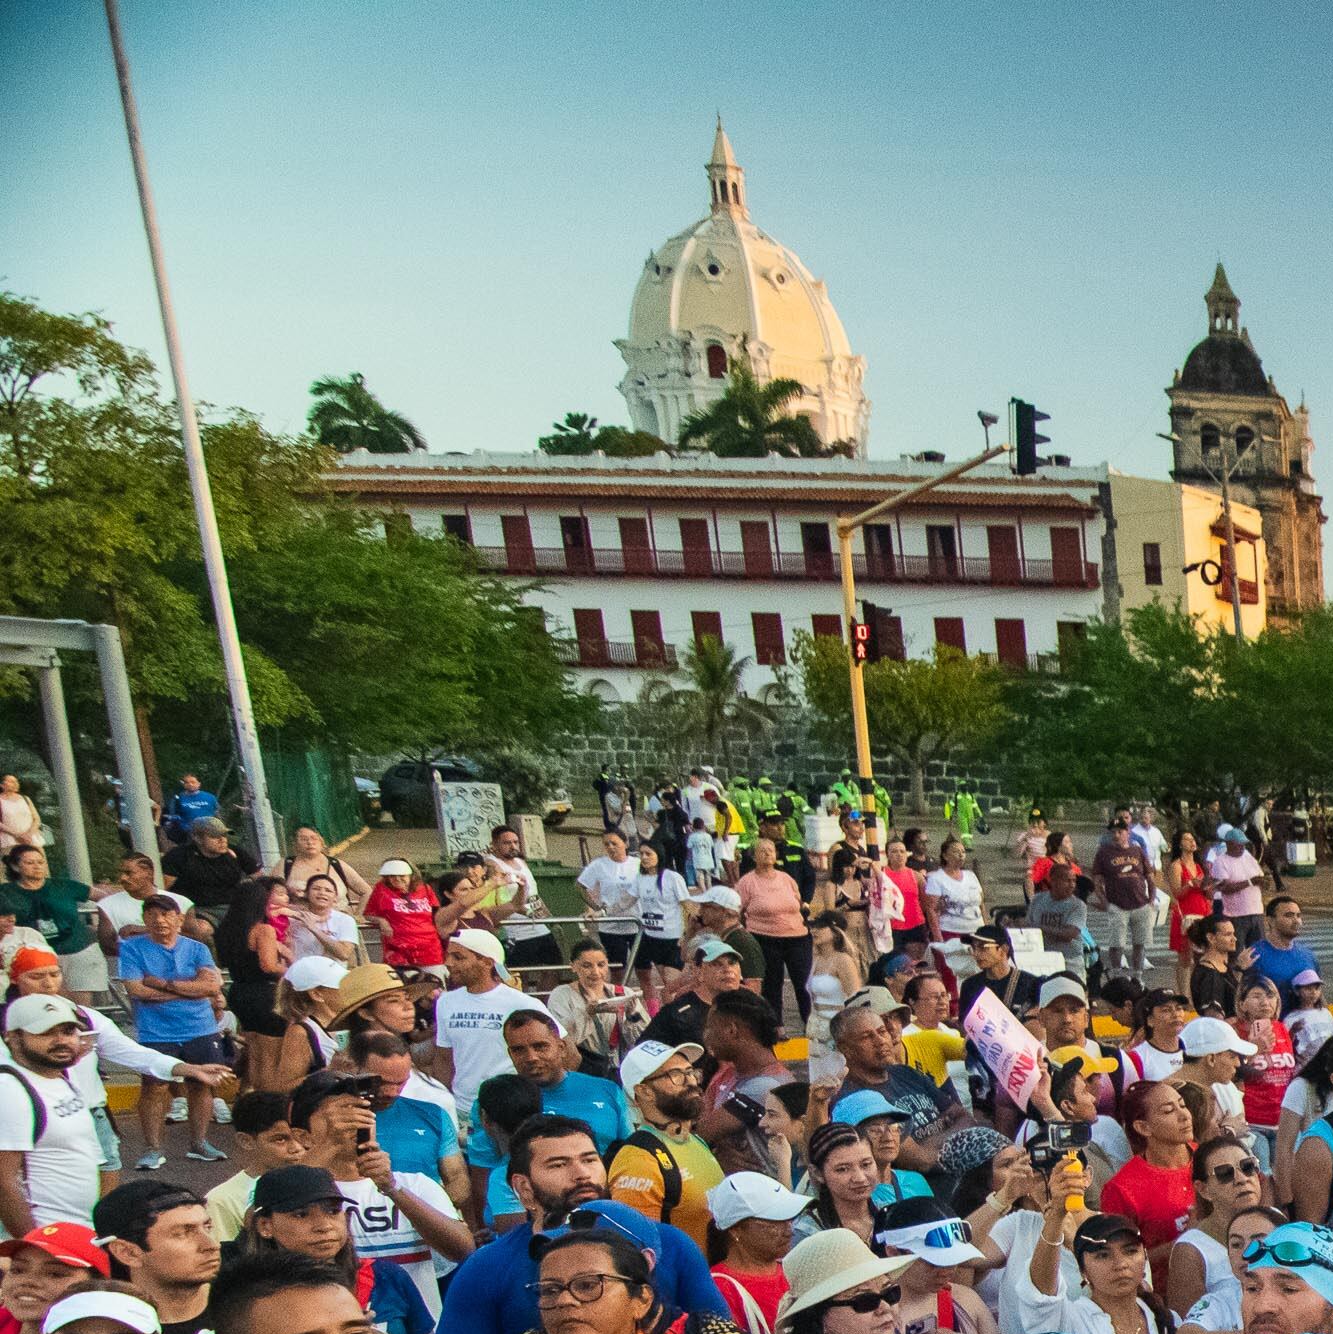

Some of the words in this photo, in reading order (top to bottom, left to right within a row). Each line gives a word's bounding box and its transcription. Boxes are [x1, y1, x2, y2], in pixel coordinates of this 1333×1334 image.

[450, 1012, 503, 1021] AMERICAN
[449, 1020, 480, 1029] EAGLE
[616, 1175, 652, 1192] COACH
